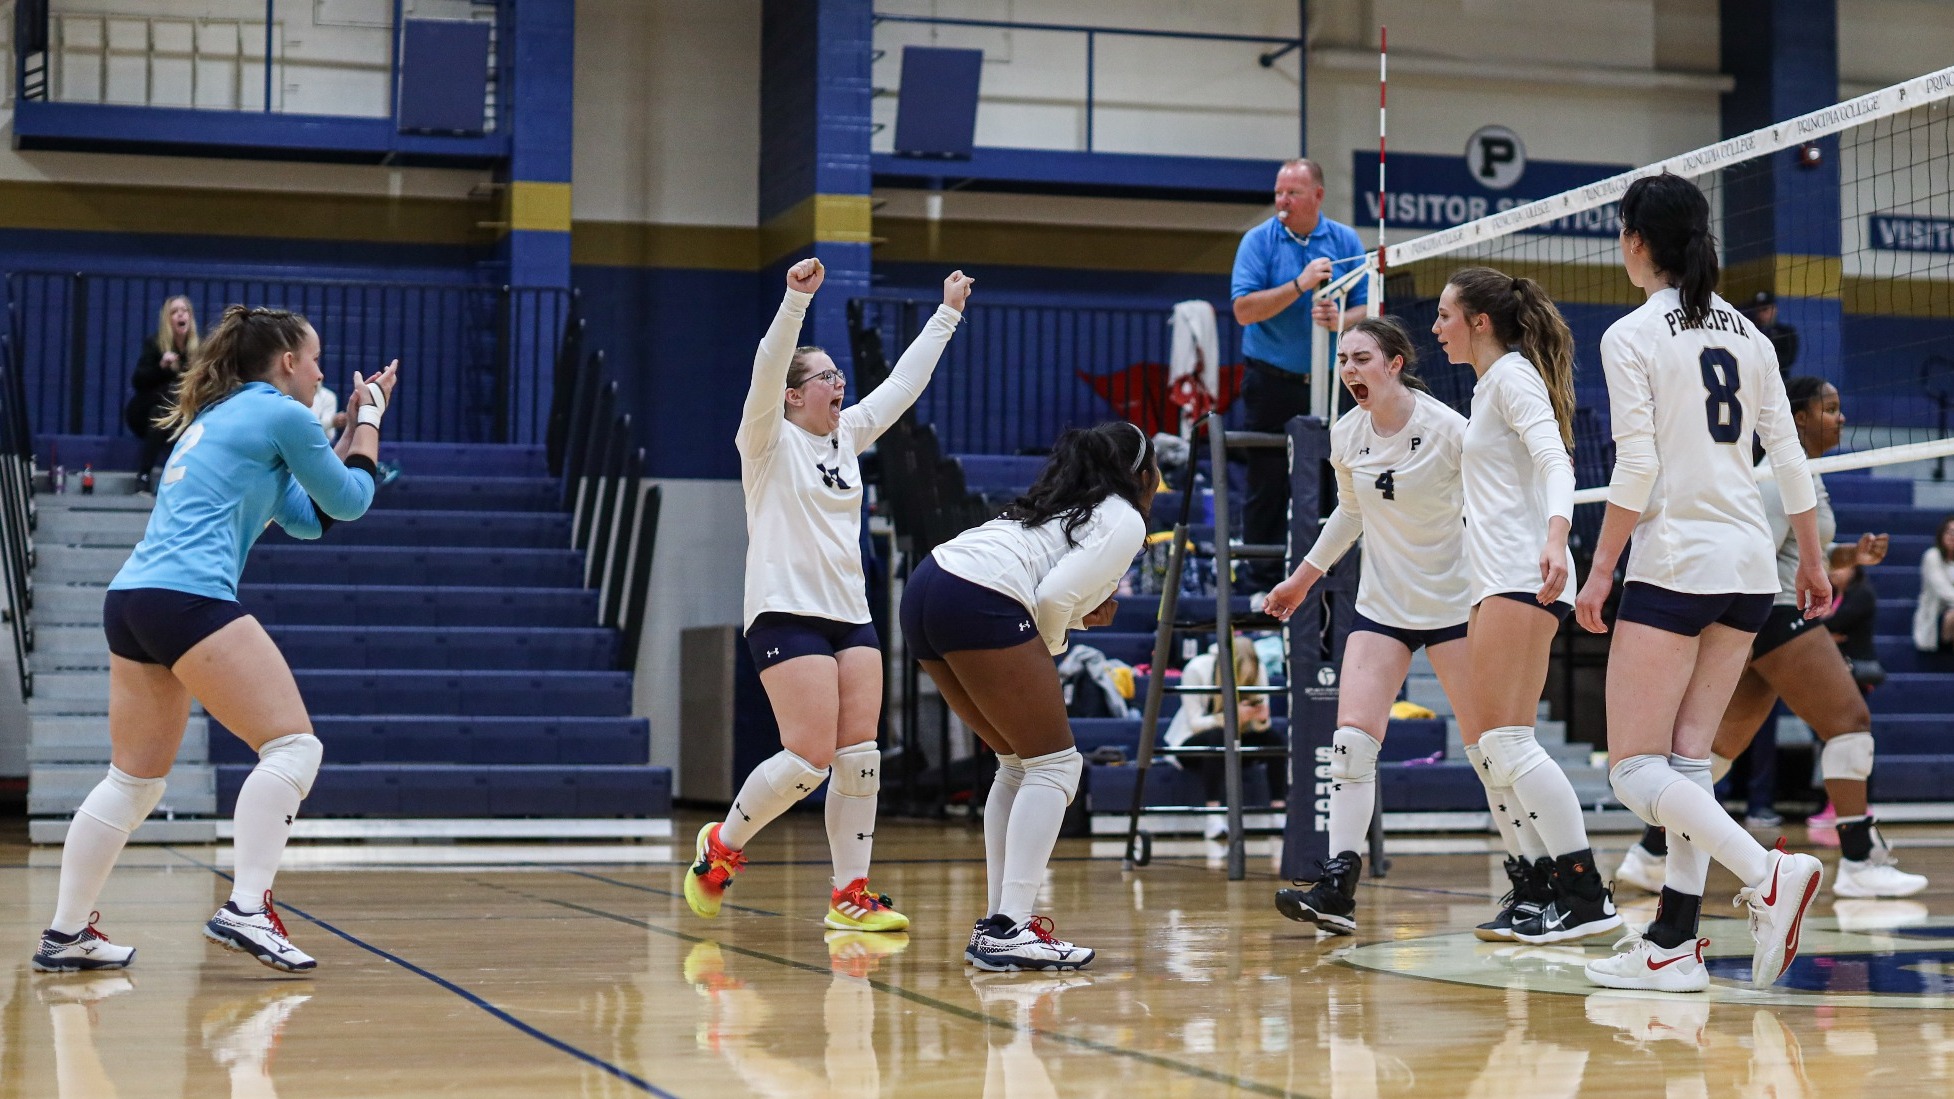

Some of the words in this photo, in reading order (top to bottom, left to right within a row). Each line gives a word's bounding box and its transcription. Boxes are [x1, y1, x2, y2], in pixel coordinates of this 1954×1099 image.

[1899, 87, 1906, 101] P
[1797, 110, 1840, 135] PRINCIPIA
[1840, 95, 1881, 121] COLLEGE
[1480, 135, 1516, 178] P
[1682, 148, 1719, 172] PRINCIPIA
[1719, 136, 1755, 160] COLLEGE
[1364, 190, 1489, 223] VISITOR
[1496, 197, 1624, 232] SION
[1879, 218, 1954, 248] VISIT
[1698, 345, 1743, 445] 8
[161, 421, 205, 486] 2
[1411, 437, 1422, 451] P
[1374, 469, 1395, 501] 4
